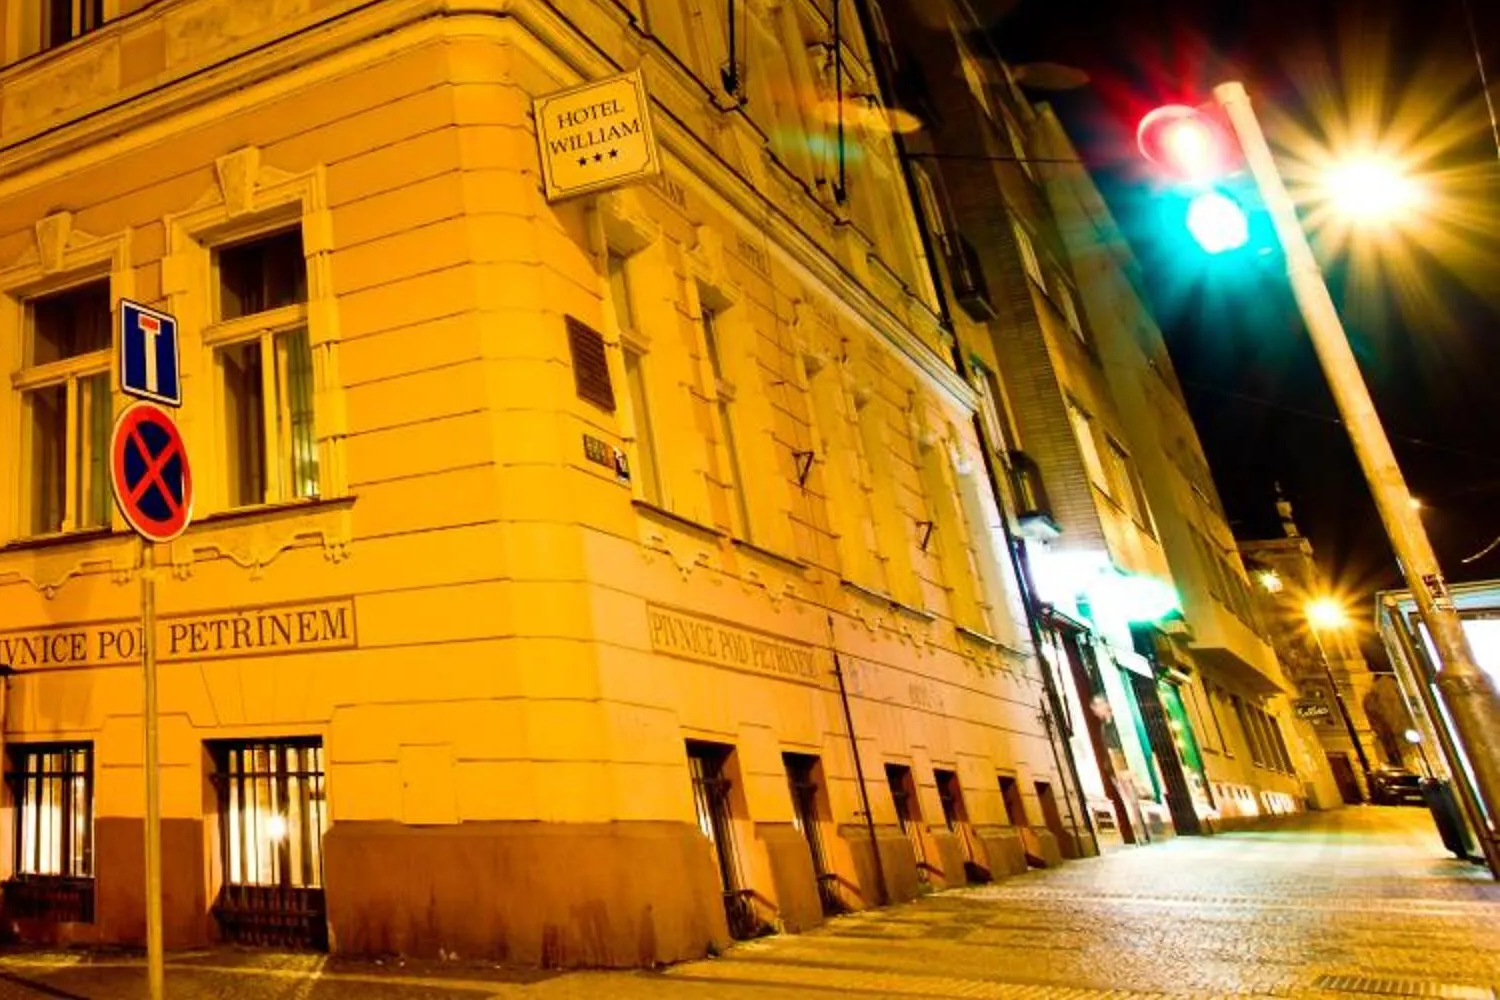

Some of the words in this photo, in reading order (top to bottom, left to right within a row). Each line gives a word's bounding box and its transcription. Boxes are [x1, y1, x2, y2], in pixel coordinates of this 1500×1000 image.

[557, 99, 625, 130] HOTEL
[549, 119, 642, 155] WILLIAM
[169, 608, 350, 654] PETŘÍNEM
[652, 612, 717, 657] PIVNICE
[717, 629, 749, 665] POD
